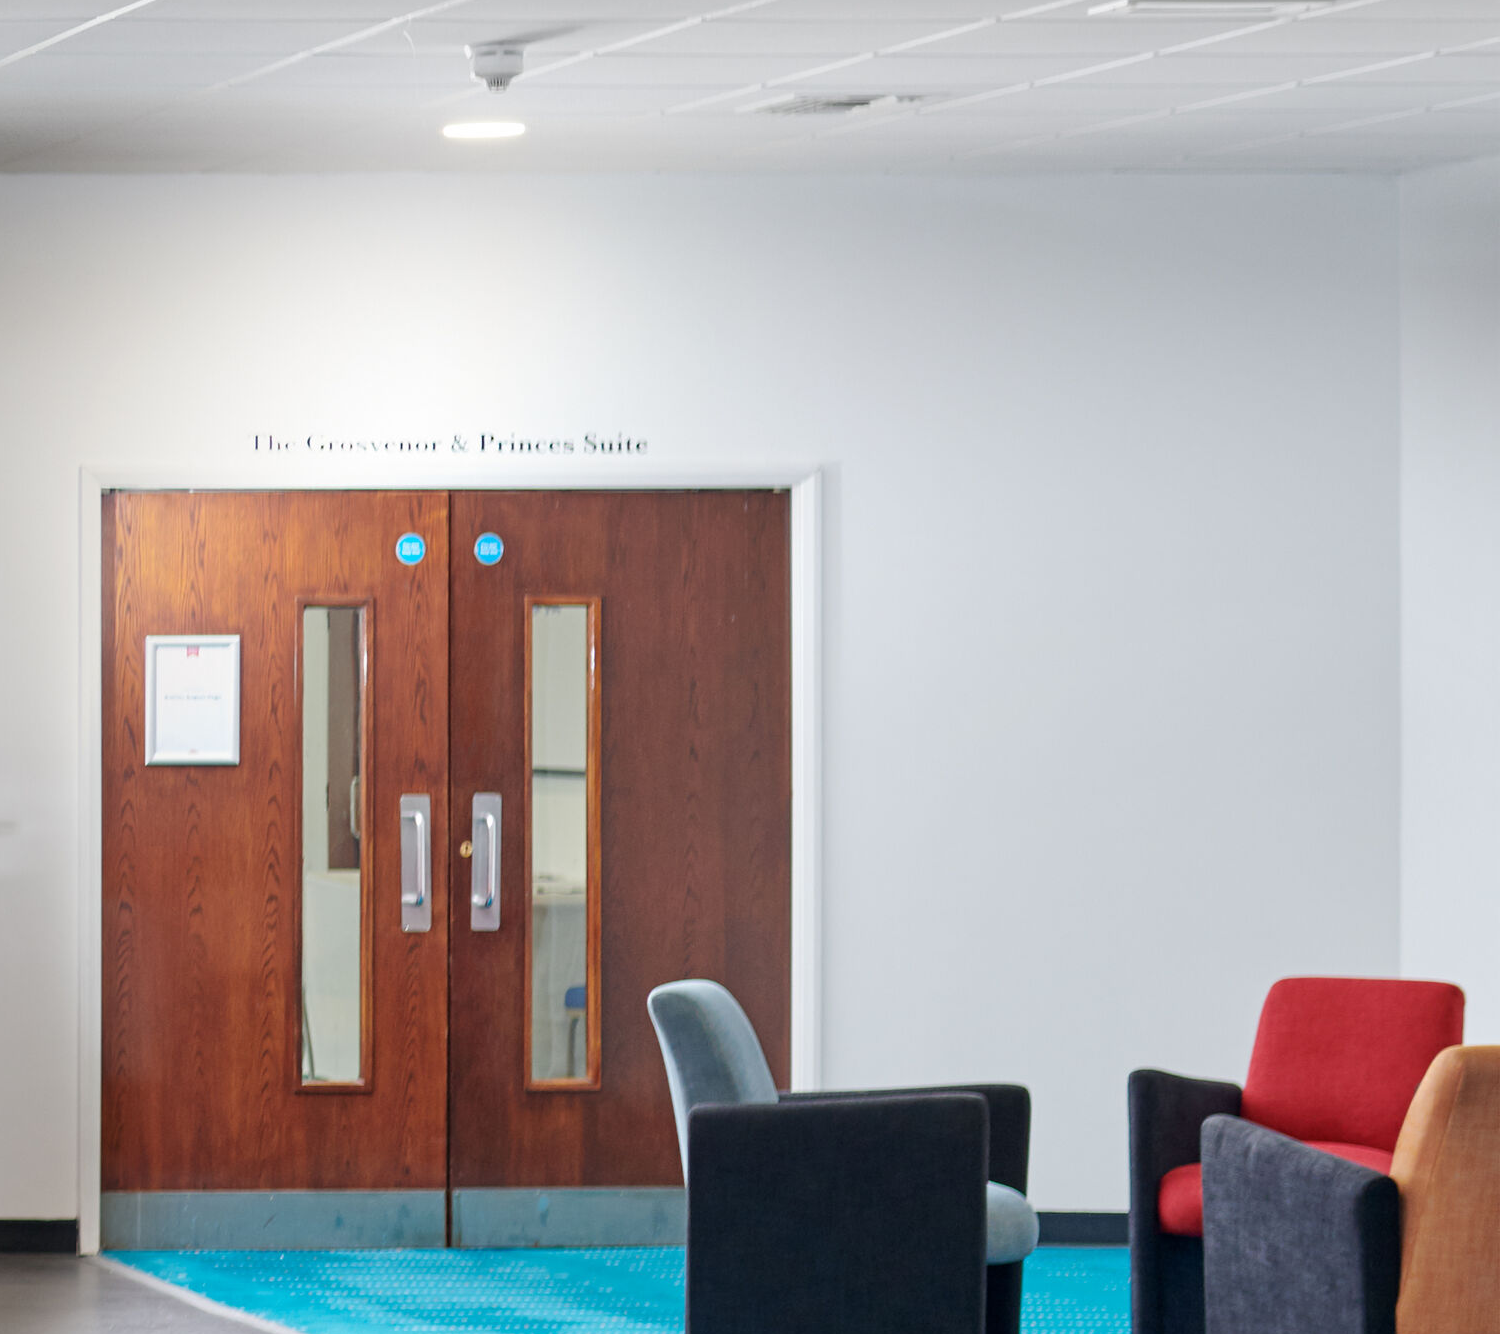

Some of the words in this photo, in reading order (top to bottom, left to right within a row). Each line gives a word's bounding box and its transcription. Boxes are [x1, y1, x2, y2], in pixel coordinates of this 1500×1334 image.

[451, 434, 469, 453] &
[479, 433, 576, 453] Princes
[583, 432, 650, 453] Suite
